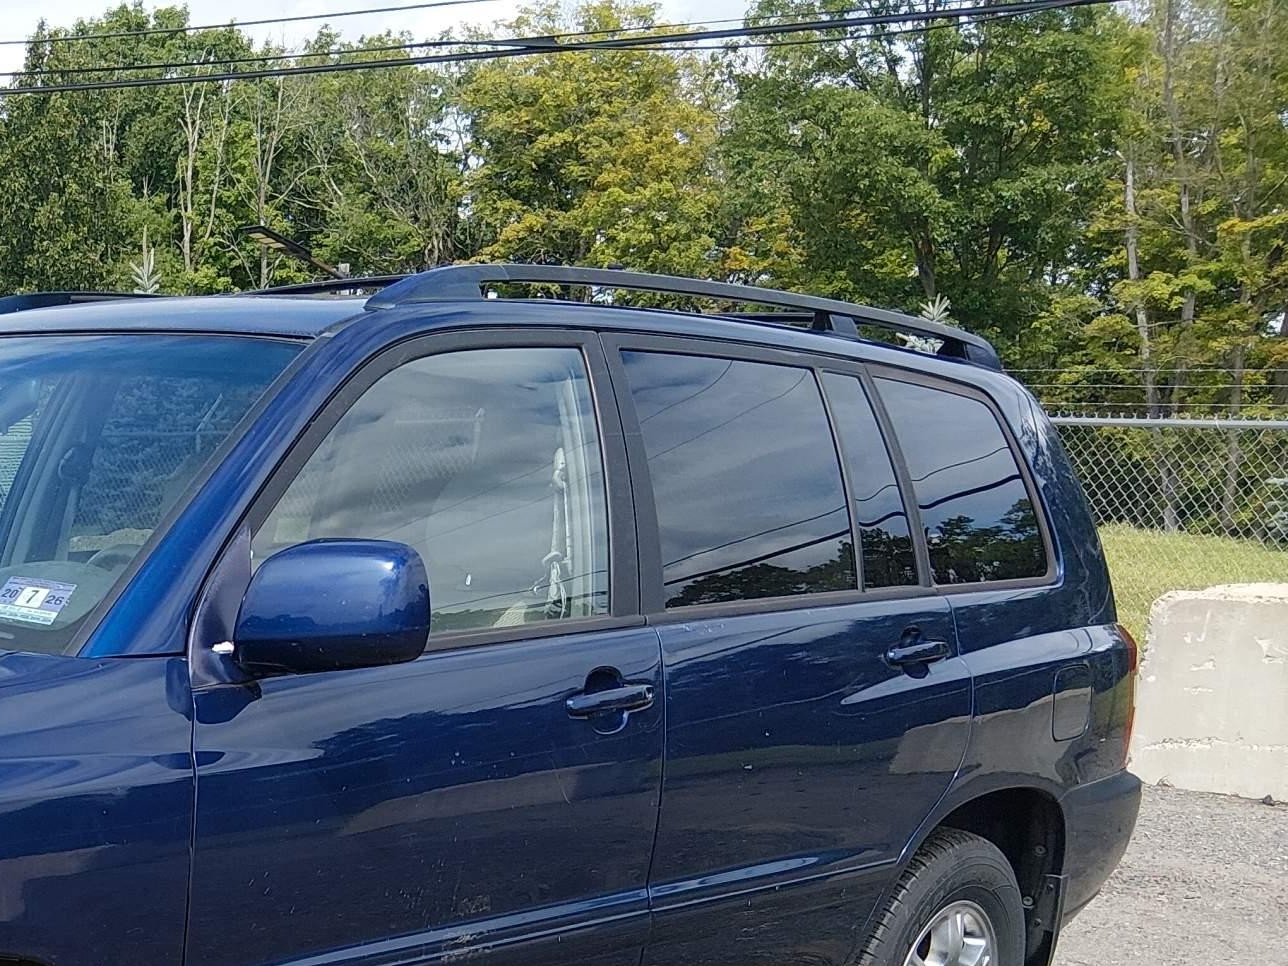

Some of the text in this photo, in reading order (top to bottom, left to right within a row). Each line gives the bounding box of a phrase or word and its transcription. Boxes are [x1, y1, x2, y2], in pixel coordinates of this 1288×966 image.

[1, 588, 19, 598] 20
[26, 590, 40, 603] 7
[45, 595, 64, 605] 26
